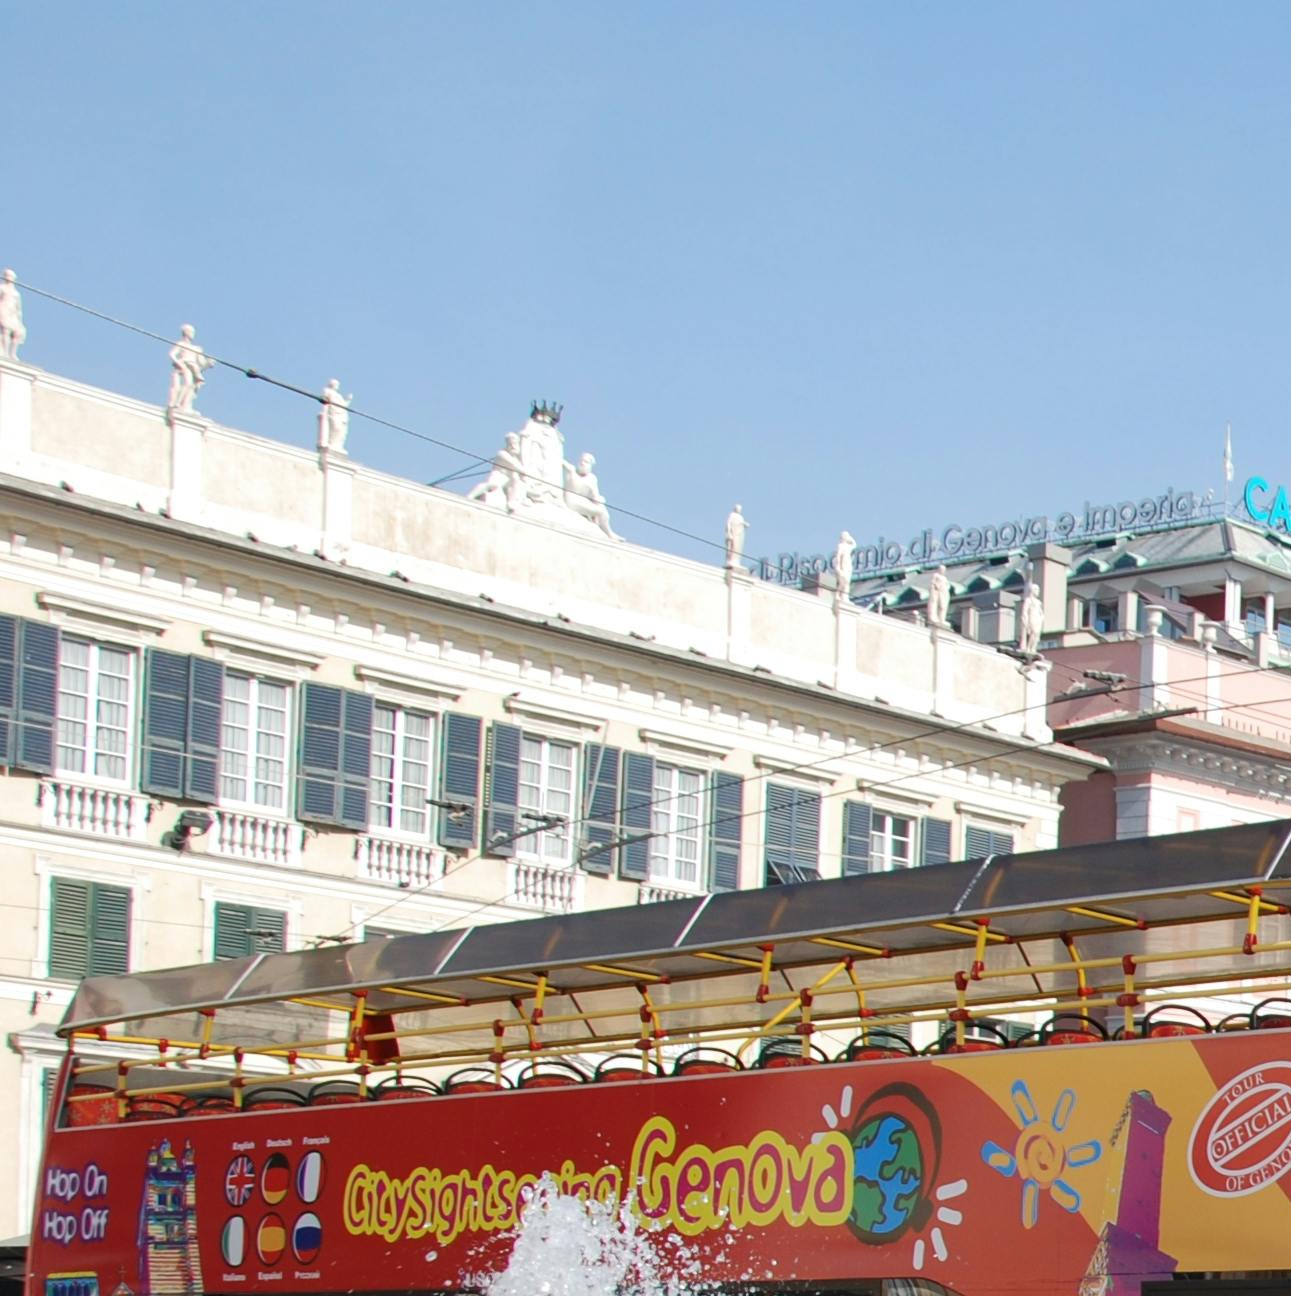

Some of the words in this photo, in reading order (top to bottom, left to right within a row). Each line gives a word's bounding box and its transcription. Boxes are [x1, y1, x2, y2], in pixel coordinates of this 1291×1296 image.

[777, 536, 901, 582] Rispmio
[910, 528, 933, 560] di
[943, 516, 1047, 555] Genova
[1056, 511, 1076, 537] e
[1083, 487, 1194, 532] Imperia
[1222, 1071, 1265, 1106] TOUR
[47, 1168, 80, 1201] Hop
[84, 1164, 107, 1197] On
[344, 1162, 622, 1244] CitySightseing
[630, 1115, 855, 1237] Genova
[1225, 1175, 1246, 1191] OF
[44, 1212, 77, 1243] Hop
[82, 1207, 109, 1240] Off
